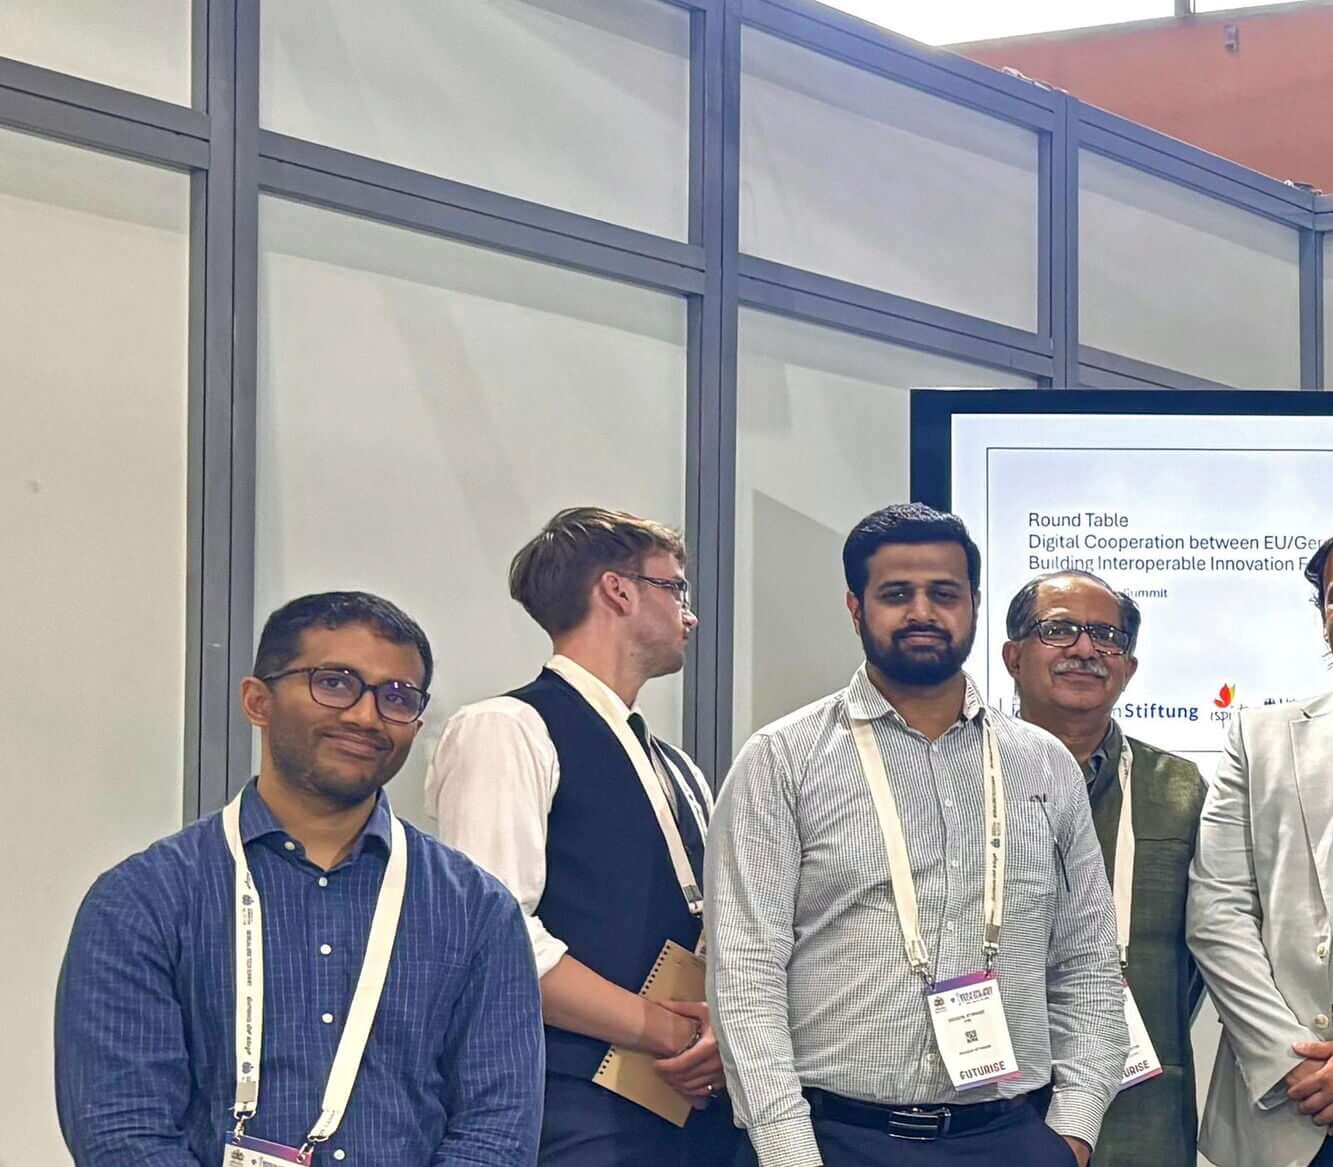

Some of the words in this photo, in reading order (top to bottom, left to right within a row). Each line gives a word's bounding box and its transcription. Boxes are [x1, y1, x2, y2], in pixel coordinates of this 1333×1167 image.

[1028, 512, 1081, 527] Round
[1085, 512, 1129, 527] Table
[1028, 534, 1079, 551] Digital
[1084, 534, 1184, 551] Cooperation
[1189, 535, 1259, 550] between
[1264, 535, 1321, 550] EU/Ge
[1028, 555, 1094, 572] Building
[1098, 555, 1206, 573] Interoperable
[1210, 556, 1295, 571] Innovation
[959, 1060, 1007, 1080] FUTURISE
[1122, 1060, 1151, 1079] URISE
